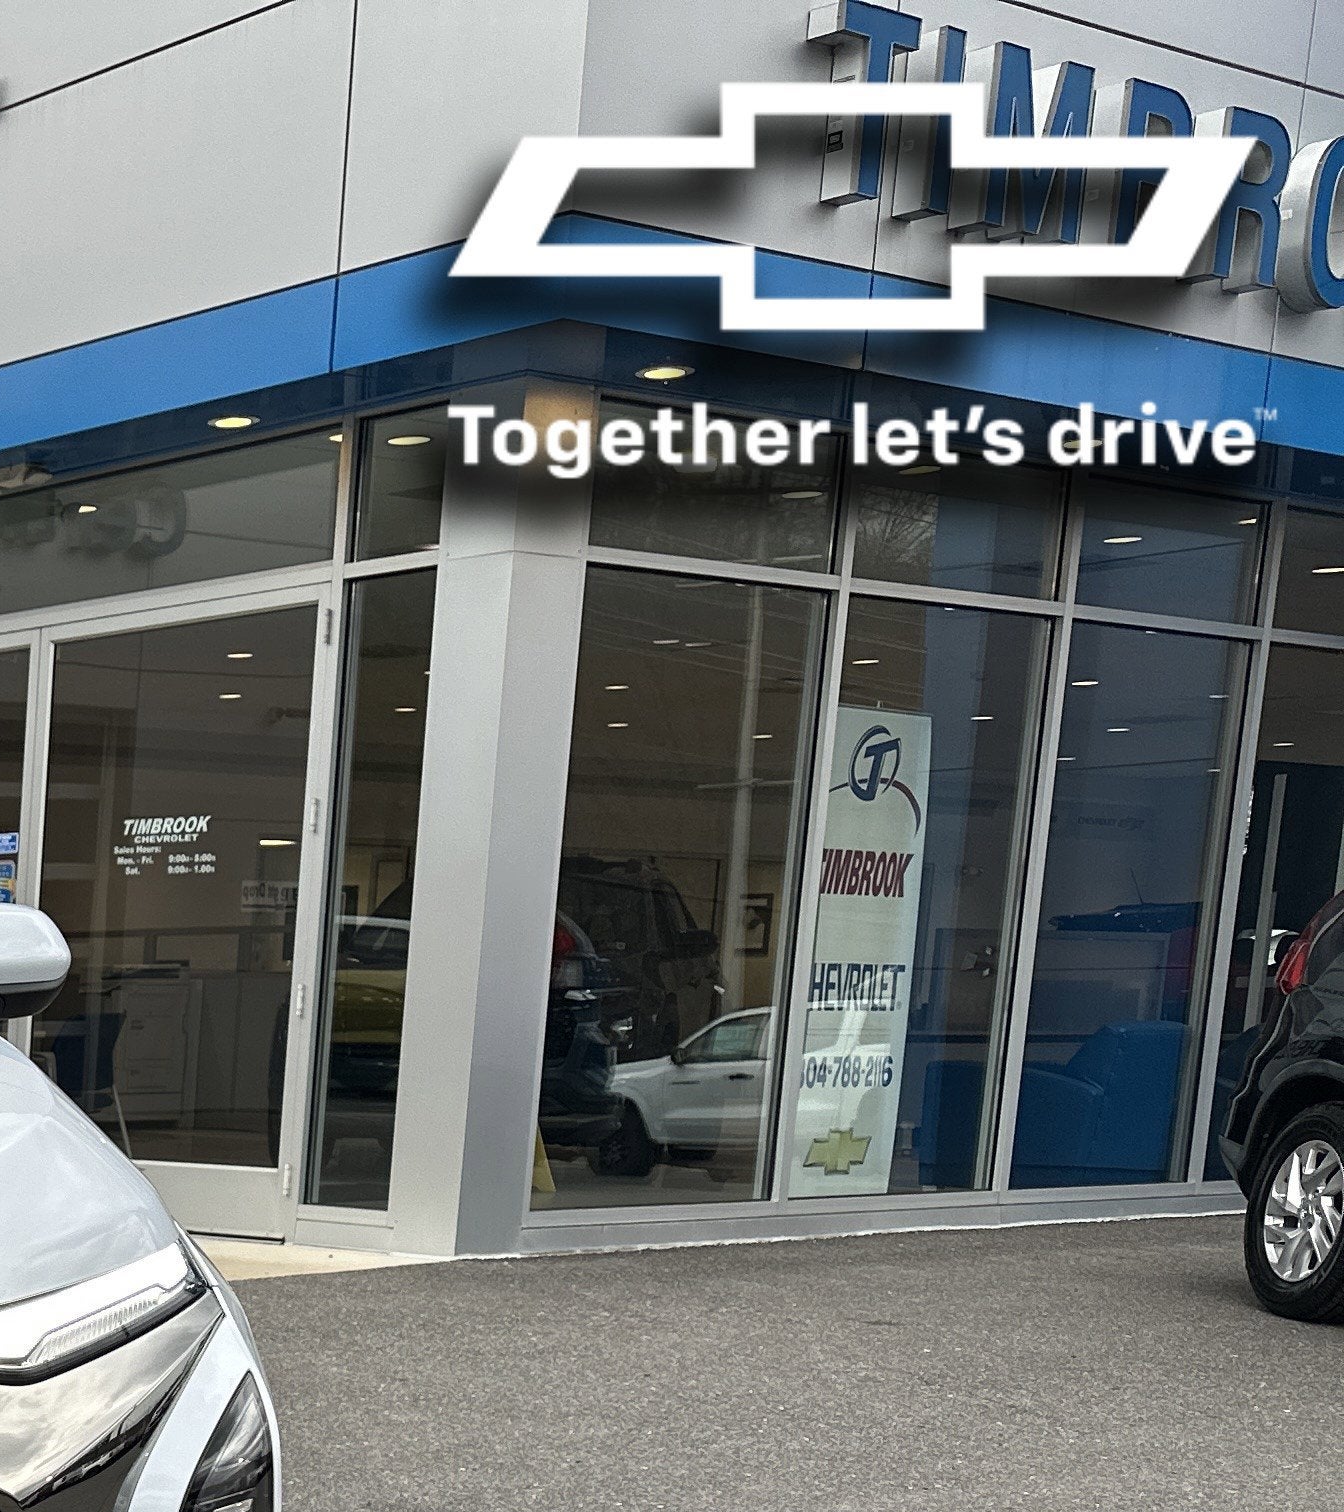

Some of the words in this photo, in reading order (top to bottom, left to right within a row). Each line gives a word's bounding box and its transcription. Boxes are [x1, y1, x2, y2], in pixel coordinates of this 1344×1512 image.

[123, 815, 212, 836] TIMBROOK
[134, 833, 199, 844] CHEVROLET
[819, 848, 915, 897] IMBROOK
[808, 963, 906, 1012] HEVROLET
